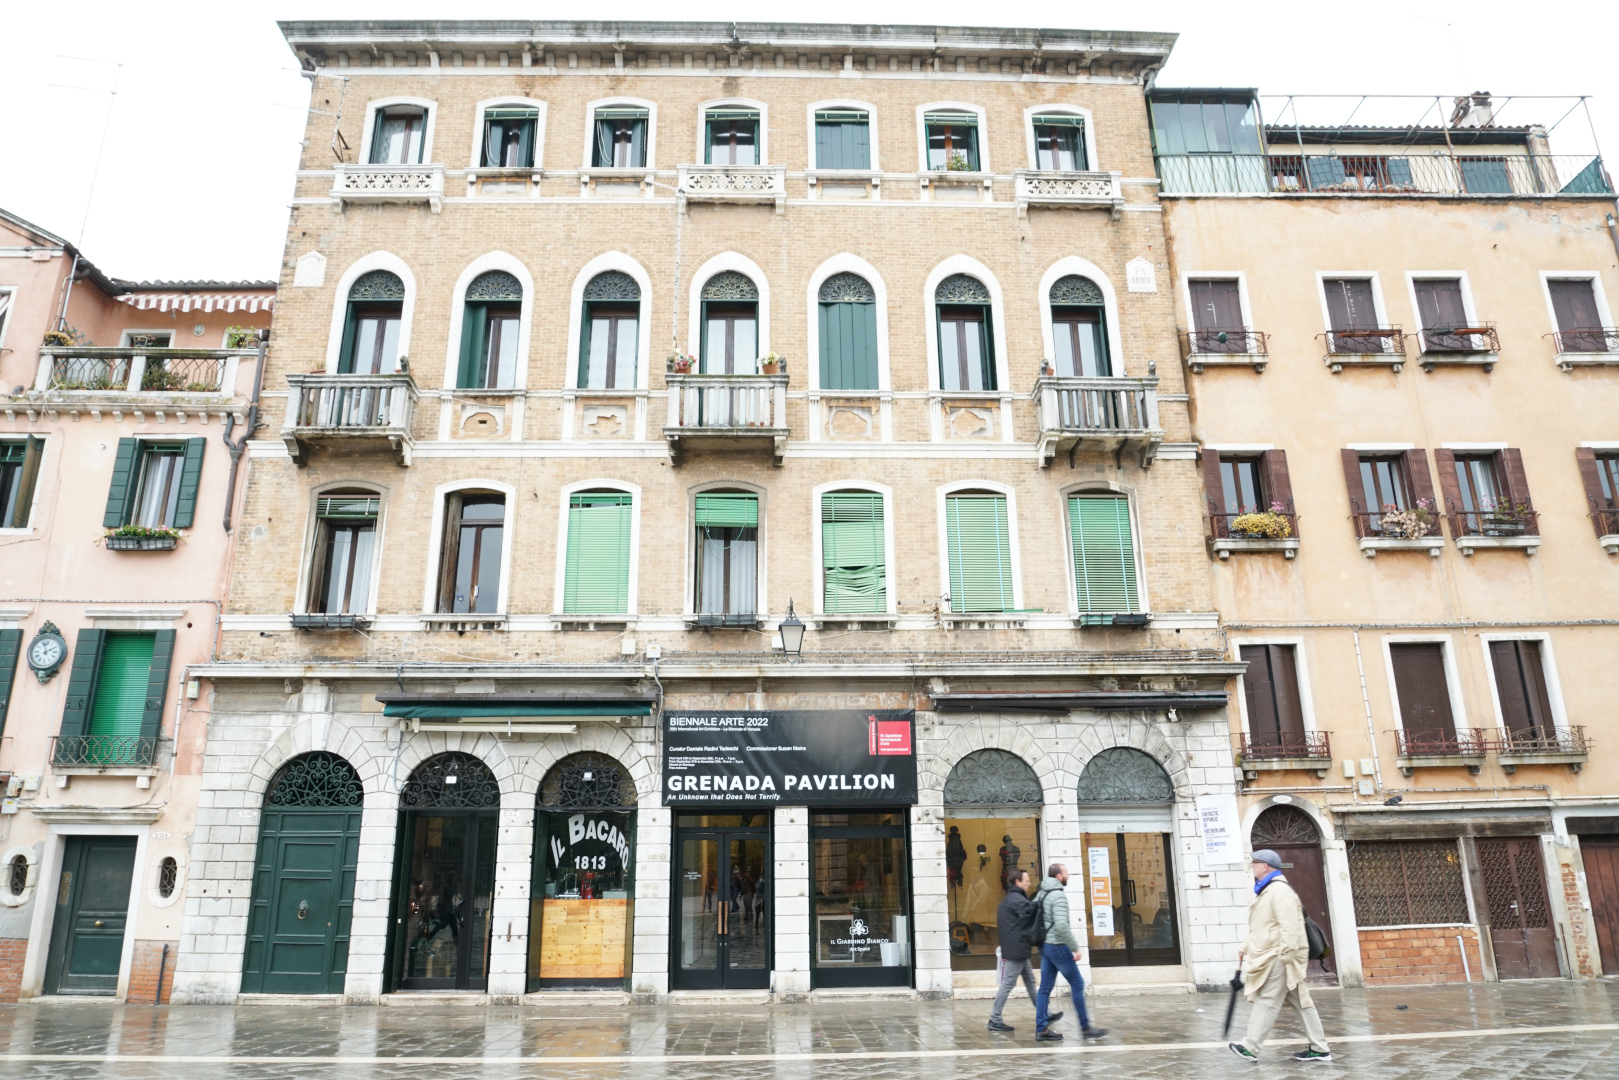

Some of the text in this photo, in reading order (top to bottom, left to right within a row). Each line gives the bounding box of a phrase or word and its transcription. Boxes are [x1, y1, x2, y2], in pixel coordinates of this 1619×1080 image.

[669, 717, 769, 726] BIENNALE ARTE 2022
[667, 774, 895, 792] GRENADA PAVILION
[759, 793, 781, 801] Terrify
[550, 813, 630, 871] IL BACARO
[574, 855, 607, 870] 1813
[836, 937, 866, 945] GIARDINO
